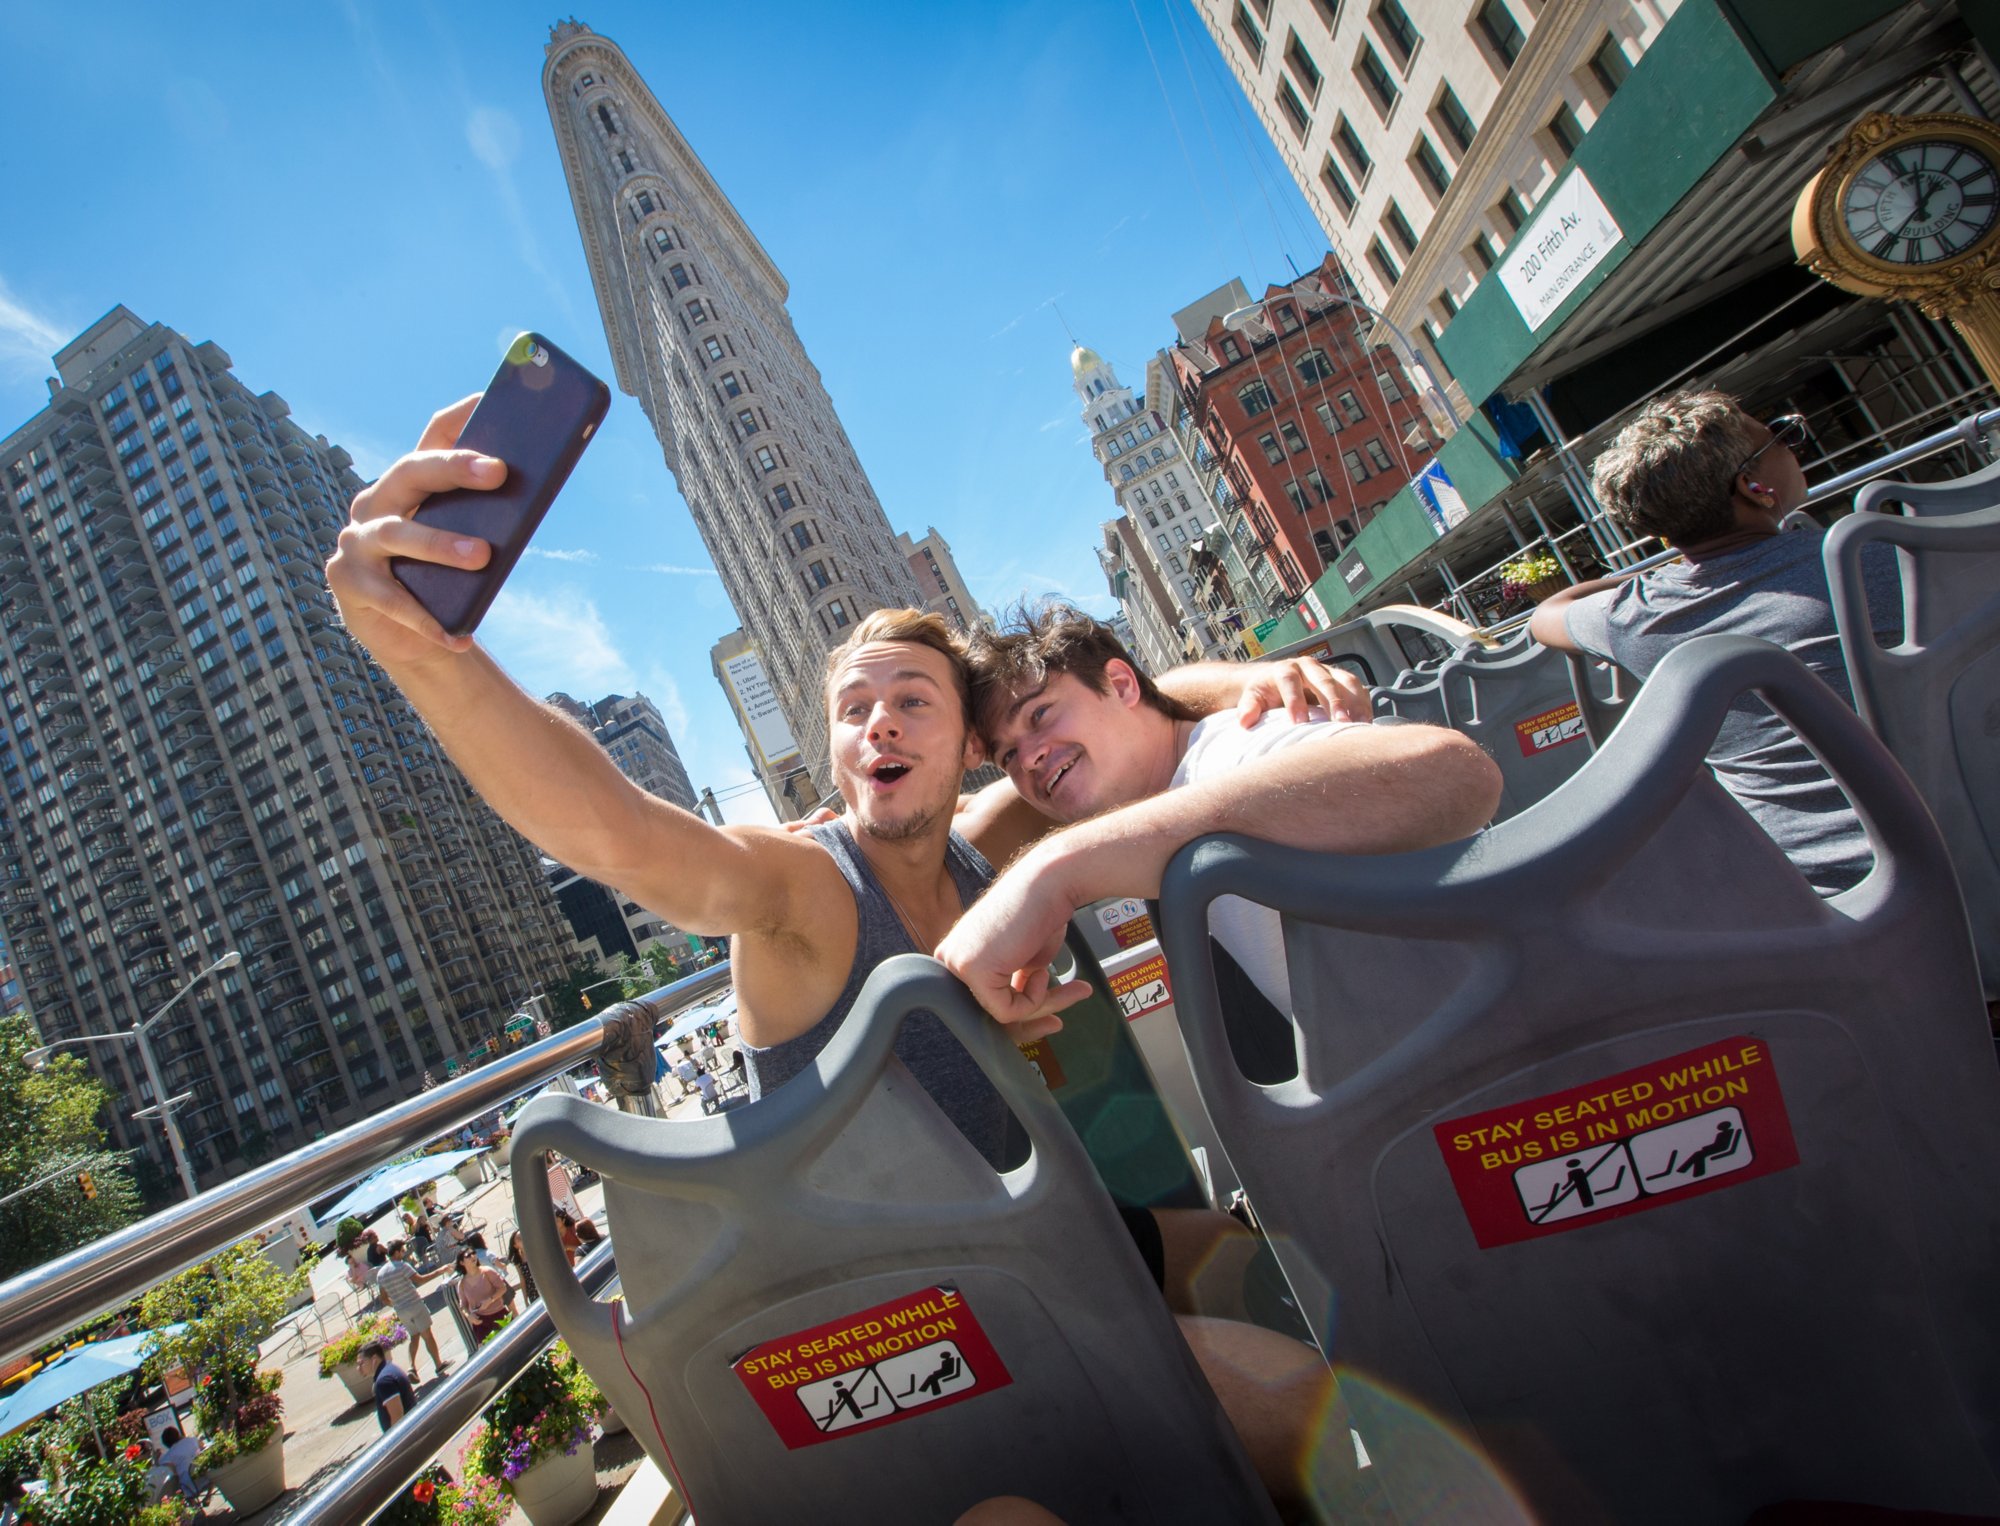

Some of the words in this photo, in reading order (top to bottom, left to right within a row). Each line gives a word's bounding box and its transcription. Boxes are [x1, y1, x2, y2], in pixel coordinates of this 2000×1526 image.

[1881, 191, 1897, 222] FIFTH
[1902, 203, 1960, 237] BUILDING
[1520, 254, 1542, 284] 200
[1537, 228, 1566, 262] Fifth
[1560, 211, 1582, 237] Av.
[1539, 283, 1560, 309] MAIN
[1557, 242, 1597, 290] ENTRANCE
[729, 662, 742, 670] Apps
[742, 658, 748, 666] of
[742, 662, 757, 671] Yorker
[743, 674, 757, 684] Uber
[757, 706, 779, 718] Swarm
[1517, 720, 1536, 731] STAY
[1537, 708, 1565, 723] SEATED
[1524, 725, 1540, 735] BUS
[1137, 959, 1165, 975] WHILE
[1121, 983, 1131, 991] IN
[1131, 969, 1164, 988] MOTION
[1453, 1118, 1525, 1151] STAY
[1534, 1081, 1654, 1129] SEATED
[1660, 1045, 1762, 1091] WHILE
[1480, 1140, 1543, 1170] BUS
[1550, 1132, 1579, 1152] IS
[1586, 1118, 1619, 1142] IN
[1626, 1077, 1749, 1131] MOTION
[743, 1349, 794, 1375] STAY
[797, 1321, 882, 1359] SEATED
[884, 1294, 961, 1329] WHILE
[767, 1367, 812, 1390] BUS
[817, 1359, 837, 1376] IS
[840, 1349, 865, 1368] IN
[869, 1317, 957, 1358] MOTION
[149, 1411, 171, 1429] BOX
